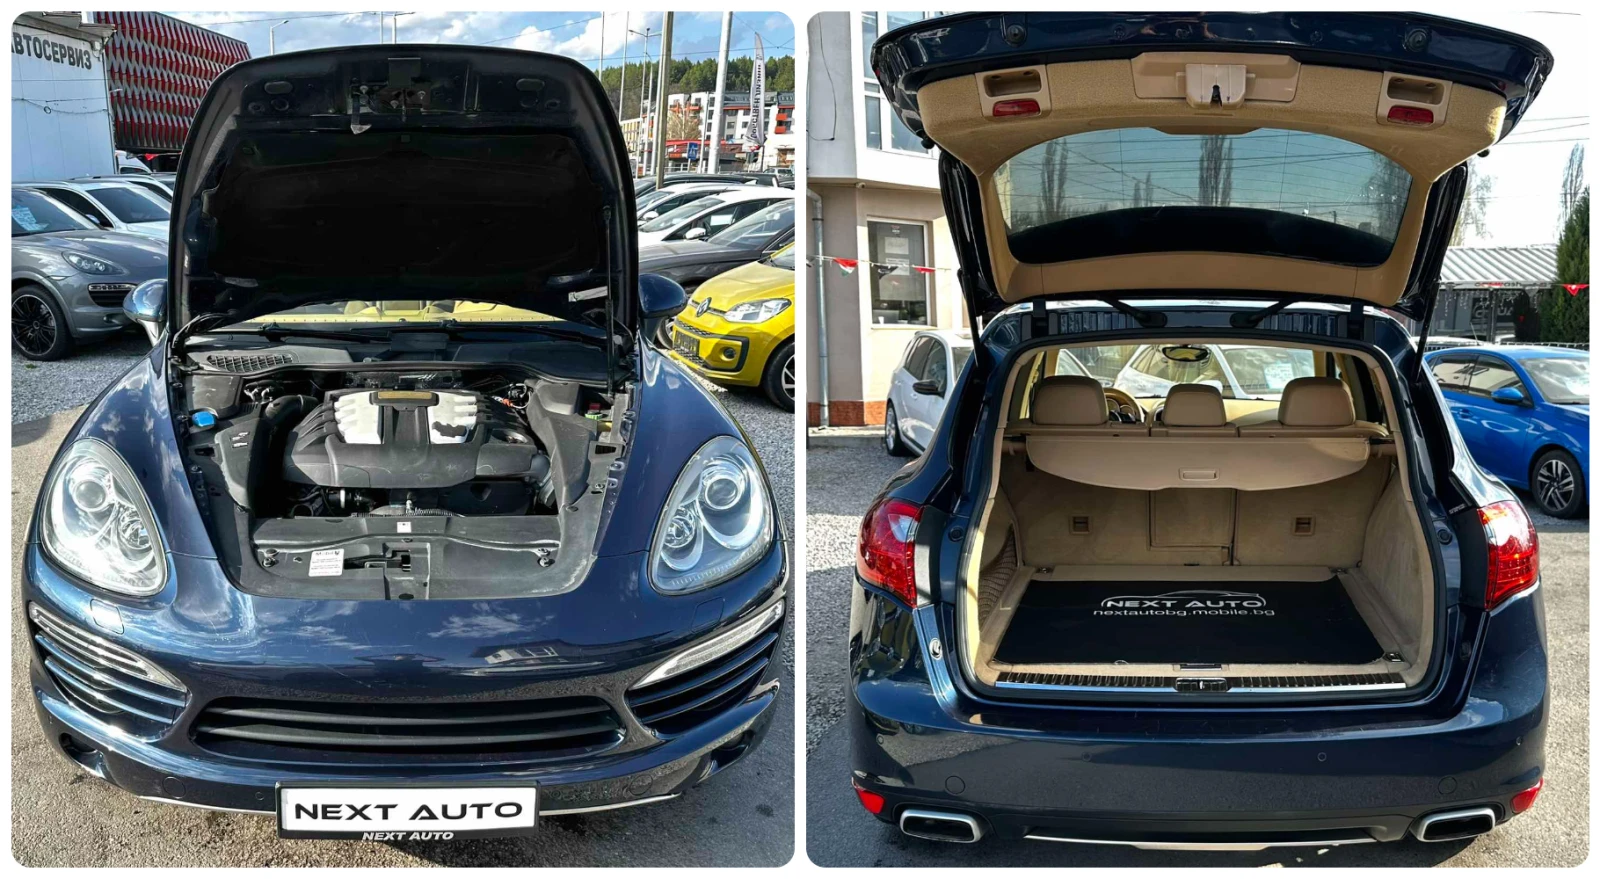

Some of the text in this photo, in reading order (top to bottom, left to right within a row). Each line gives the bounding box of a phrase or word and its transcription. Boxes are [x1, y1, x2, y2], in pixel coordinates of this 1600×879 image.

[1106, 600, 1263, 608] NEXT AUTO
[294, 801, 523, 821] NEXT AUTO
[362, 831, 454, 841] NEXT AUTO
